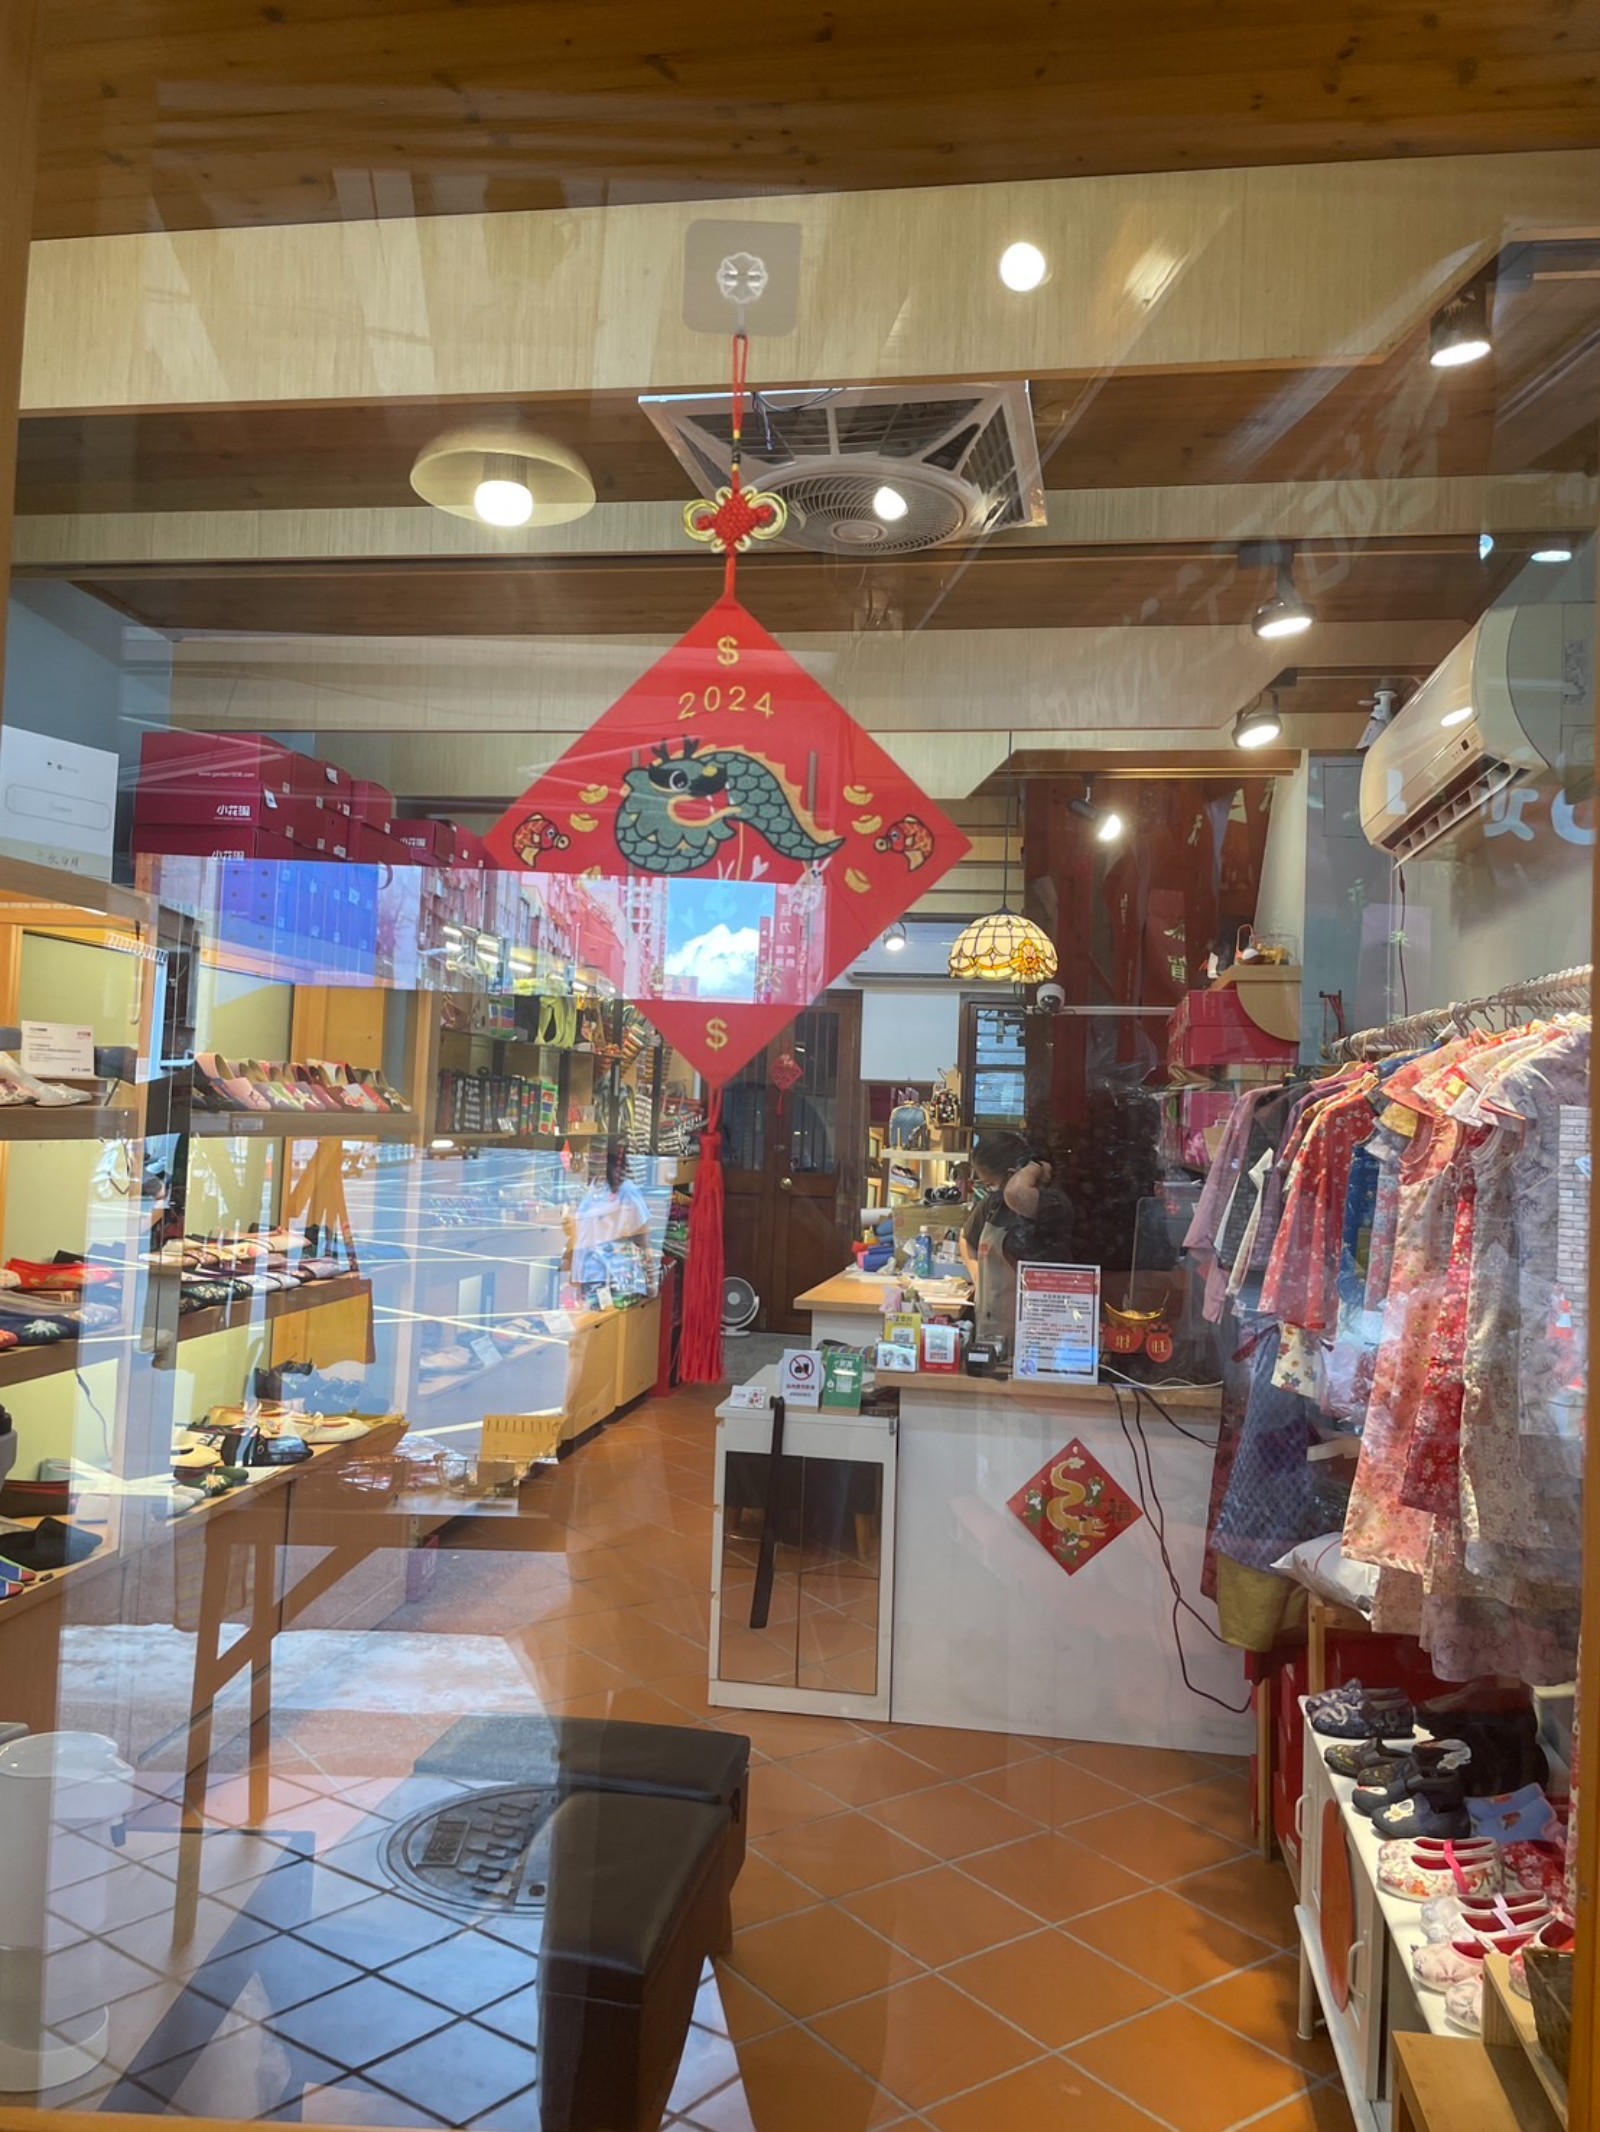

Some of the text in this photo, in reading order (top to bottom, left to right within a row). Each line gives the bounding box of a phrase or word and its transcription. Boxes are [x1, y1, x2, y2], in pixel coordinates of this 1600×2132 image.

[717, 635, 740, 668] $
[677, 685, 775, 720] 2024
[705, 1016, 728, 1052] $
